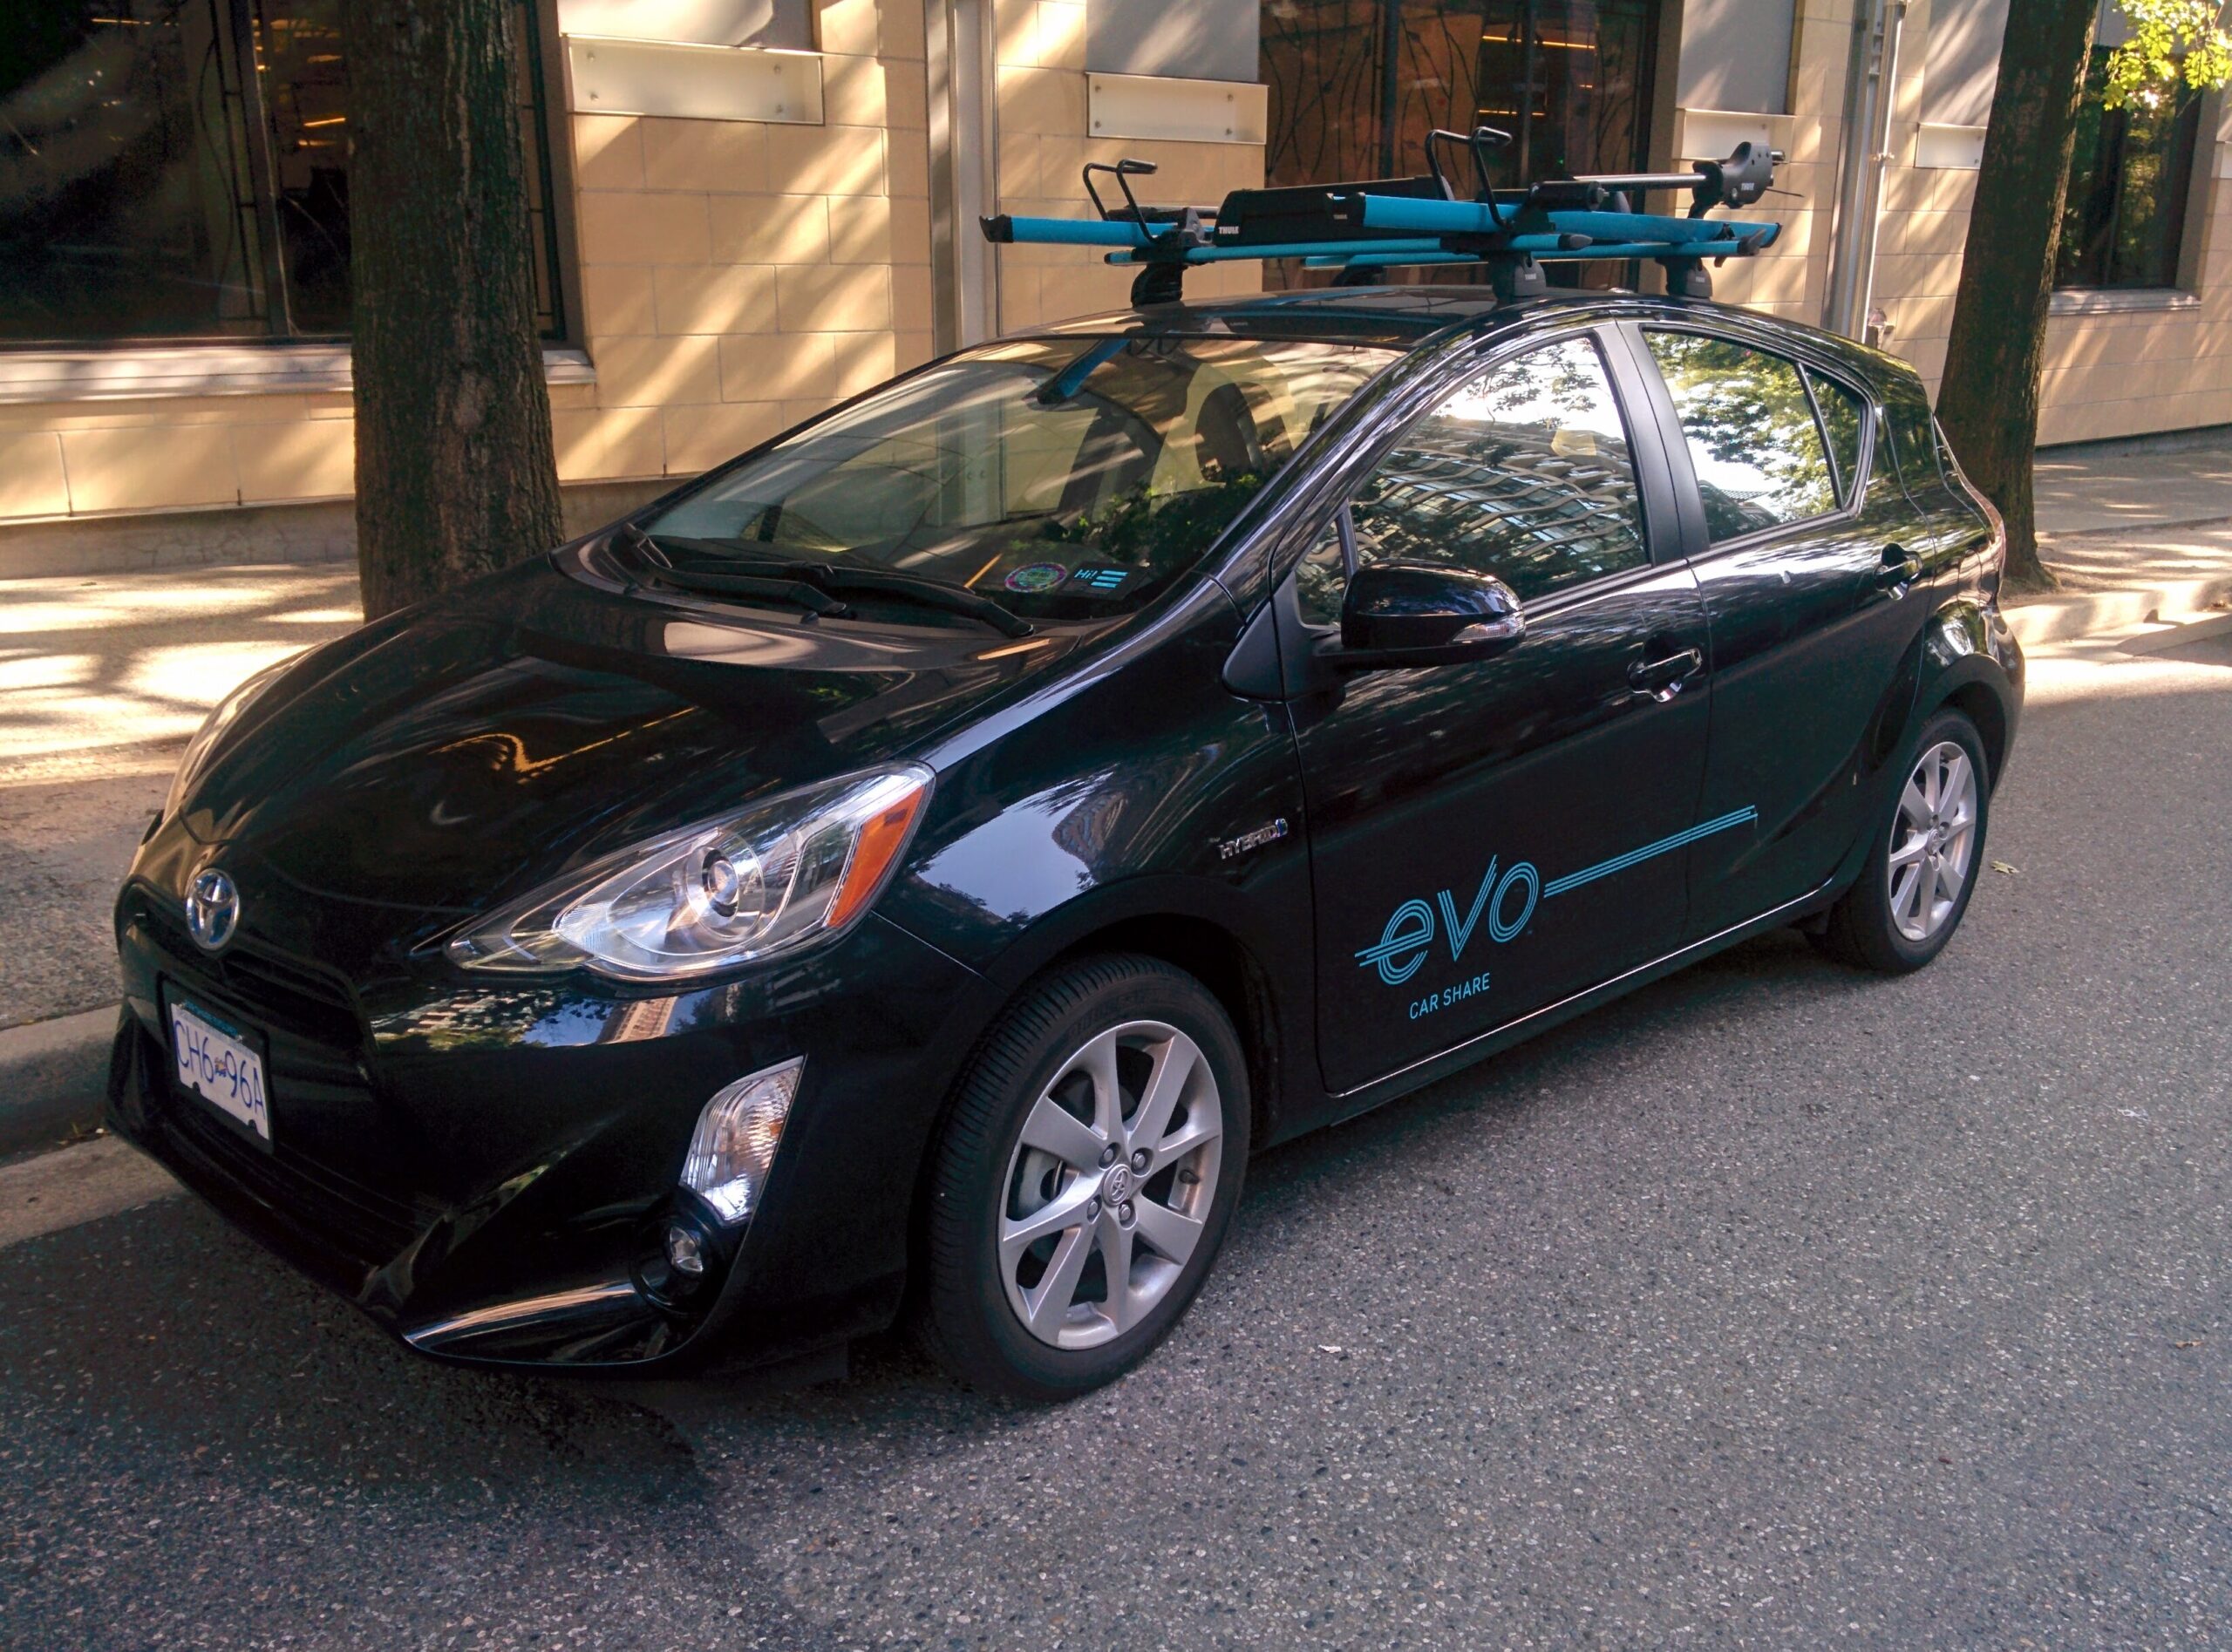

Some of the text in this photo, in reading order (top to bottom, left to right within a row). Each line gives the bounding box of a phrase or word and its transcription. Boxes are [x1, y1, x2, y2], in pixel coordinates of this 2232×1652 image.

[1074, 569, 1098, 579] Hi!
[1355, 854, 1539, 985] evo
[1410, 973, 1490, 1020] CAR SHARE
[174, 1020, 266, 1119] CH6 96A
